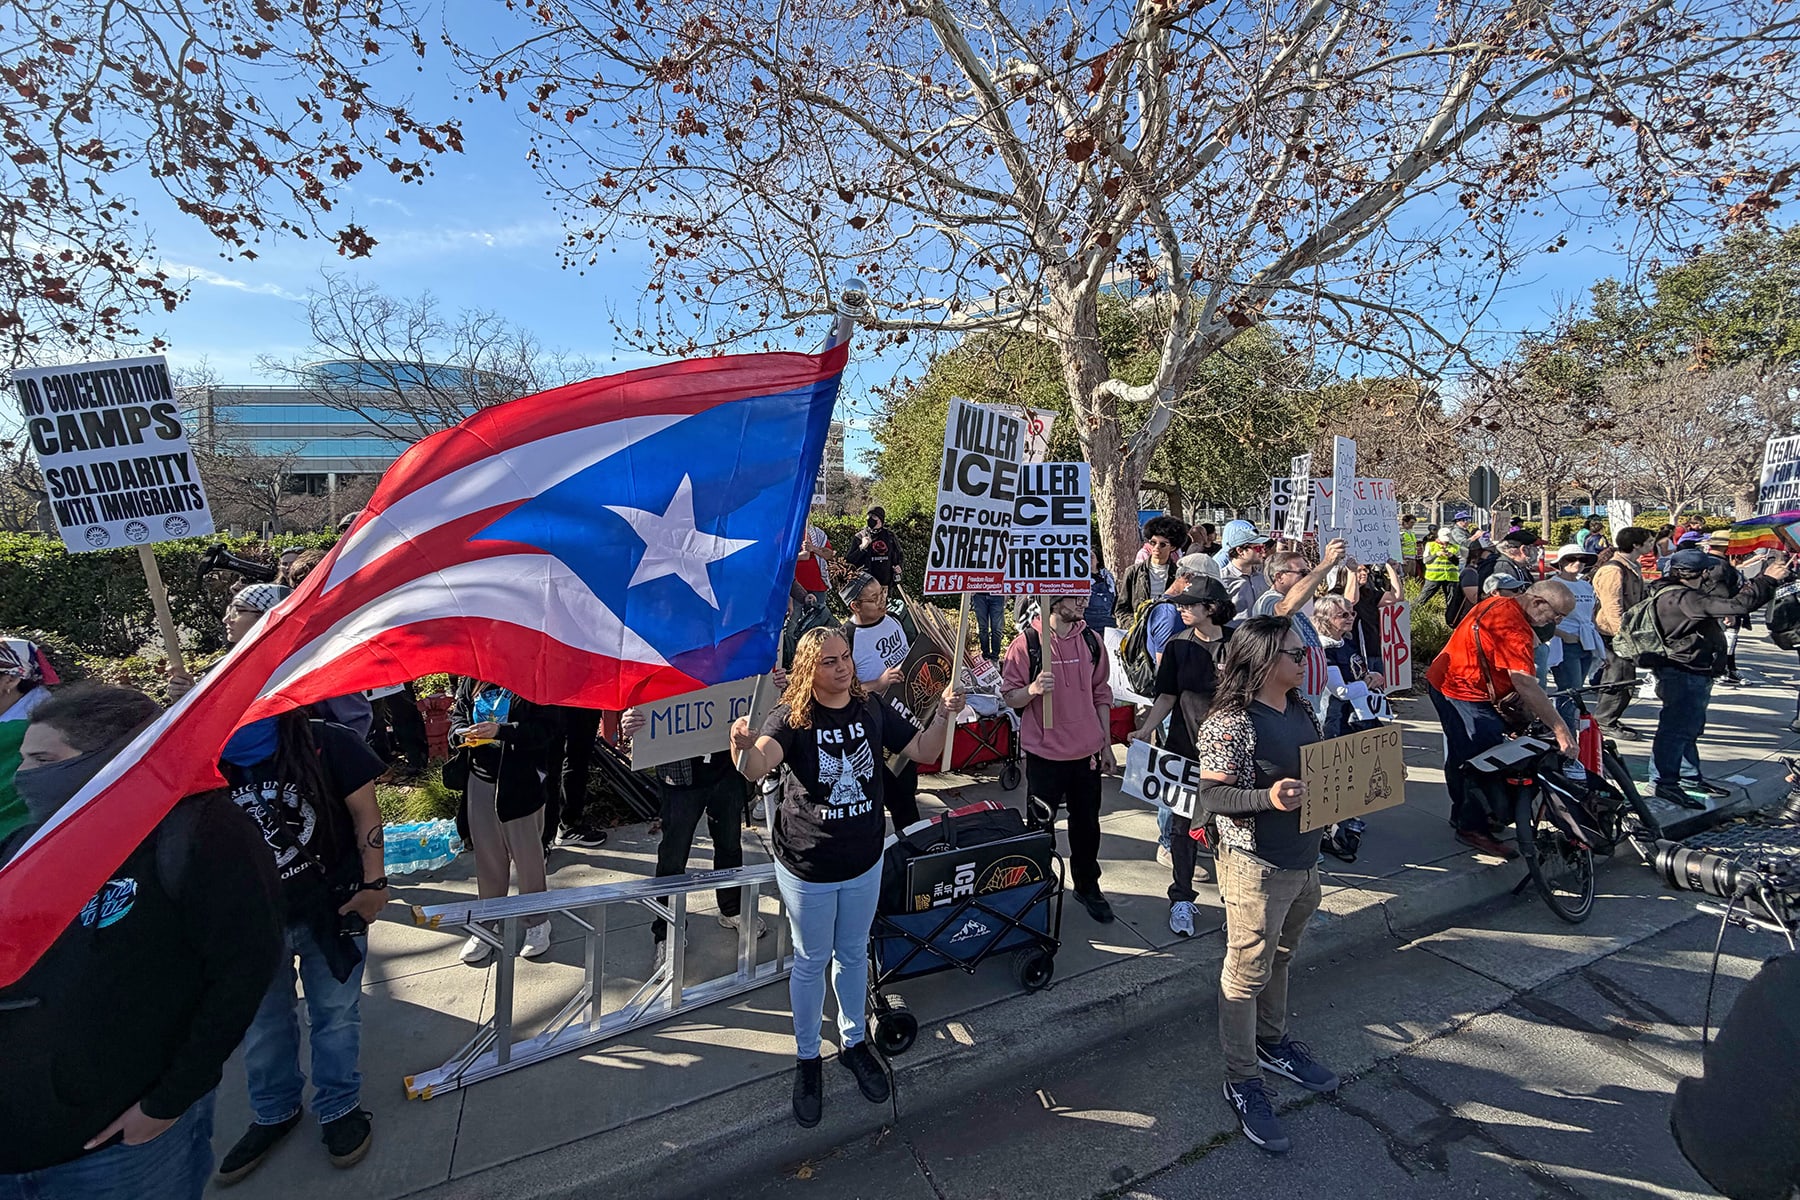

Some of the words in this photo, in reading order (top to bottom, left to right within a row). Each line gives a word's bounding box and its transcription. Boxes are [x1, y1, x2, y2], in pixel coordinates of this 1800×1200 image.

[16, 378, 45, 416] NO
[42, 364, 174, 413] CONCENTRATION
[29, 402, 182, 456] CAMPS
[955, 402, 1019, 462] KILLER
[1768, 439, 1800, 464] LEGALI
[46, 452, 192, 499] SOLIDARITY
[942, 447, 1019, 502] ICE
[1016, 464, 1079, 496] ILLER
[1773, 463, 1792, 482] FOR
[53, 497, 99, 528] WITH
[97, 483, 205, 522] IMMIGRANTS
[1761, 483, 1800, 500] SOLIDA
[939, 503, 976, 524] OFF
[977, 509, 1012, 529] OUR
[1012, 496, 1087, 526] CE
[1356, 518, 1380, 533] Jesus
[931, 524, 1009, 570] STREETS
[1009, 534, 1036, 546] FF
[1040, 533, 1088, 546] OUR
[1353, 535, 1373, 550] Mary
[1008, 547, 1089, 578] TREETS
[1379, 605, 1405, 645] CK
[876, 629, 903, 659] Bay
[651, 701, 715, 740] MELTS
[816, 729, 844, 745] ICE
[848, 722, 865, 740] IS
[1147, 748, 1200, 787] ICE
[1305, 738, 1355, 776] KLAN
[1360, 731, 1398, 755] GTFO
[1142, 775, 1198, 813] OUT
[820, 808, 845, 820] THE
[848, 800, 873, 817] KKK
[933, 881, 944, 897] THE
[943, 884, 953, 895] OF
[953, 862, 976, 898] ICE
